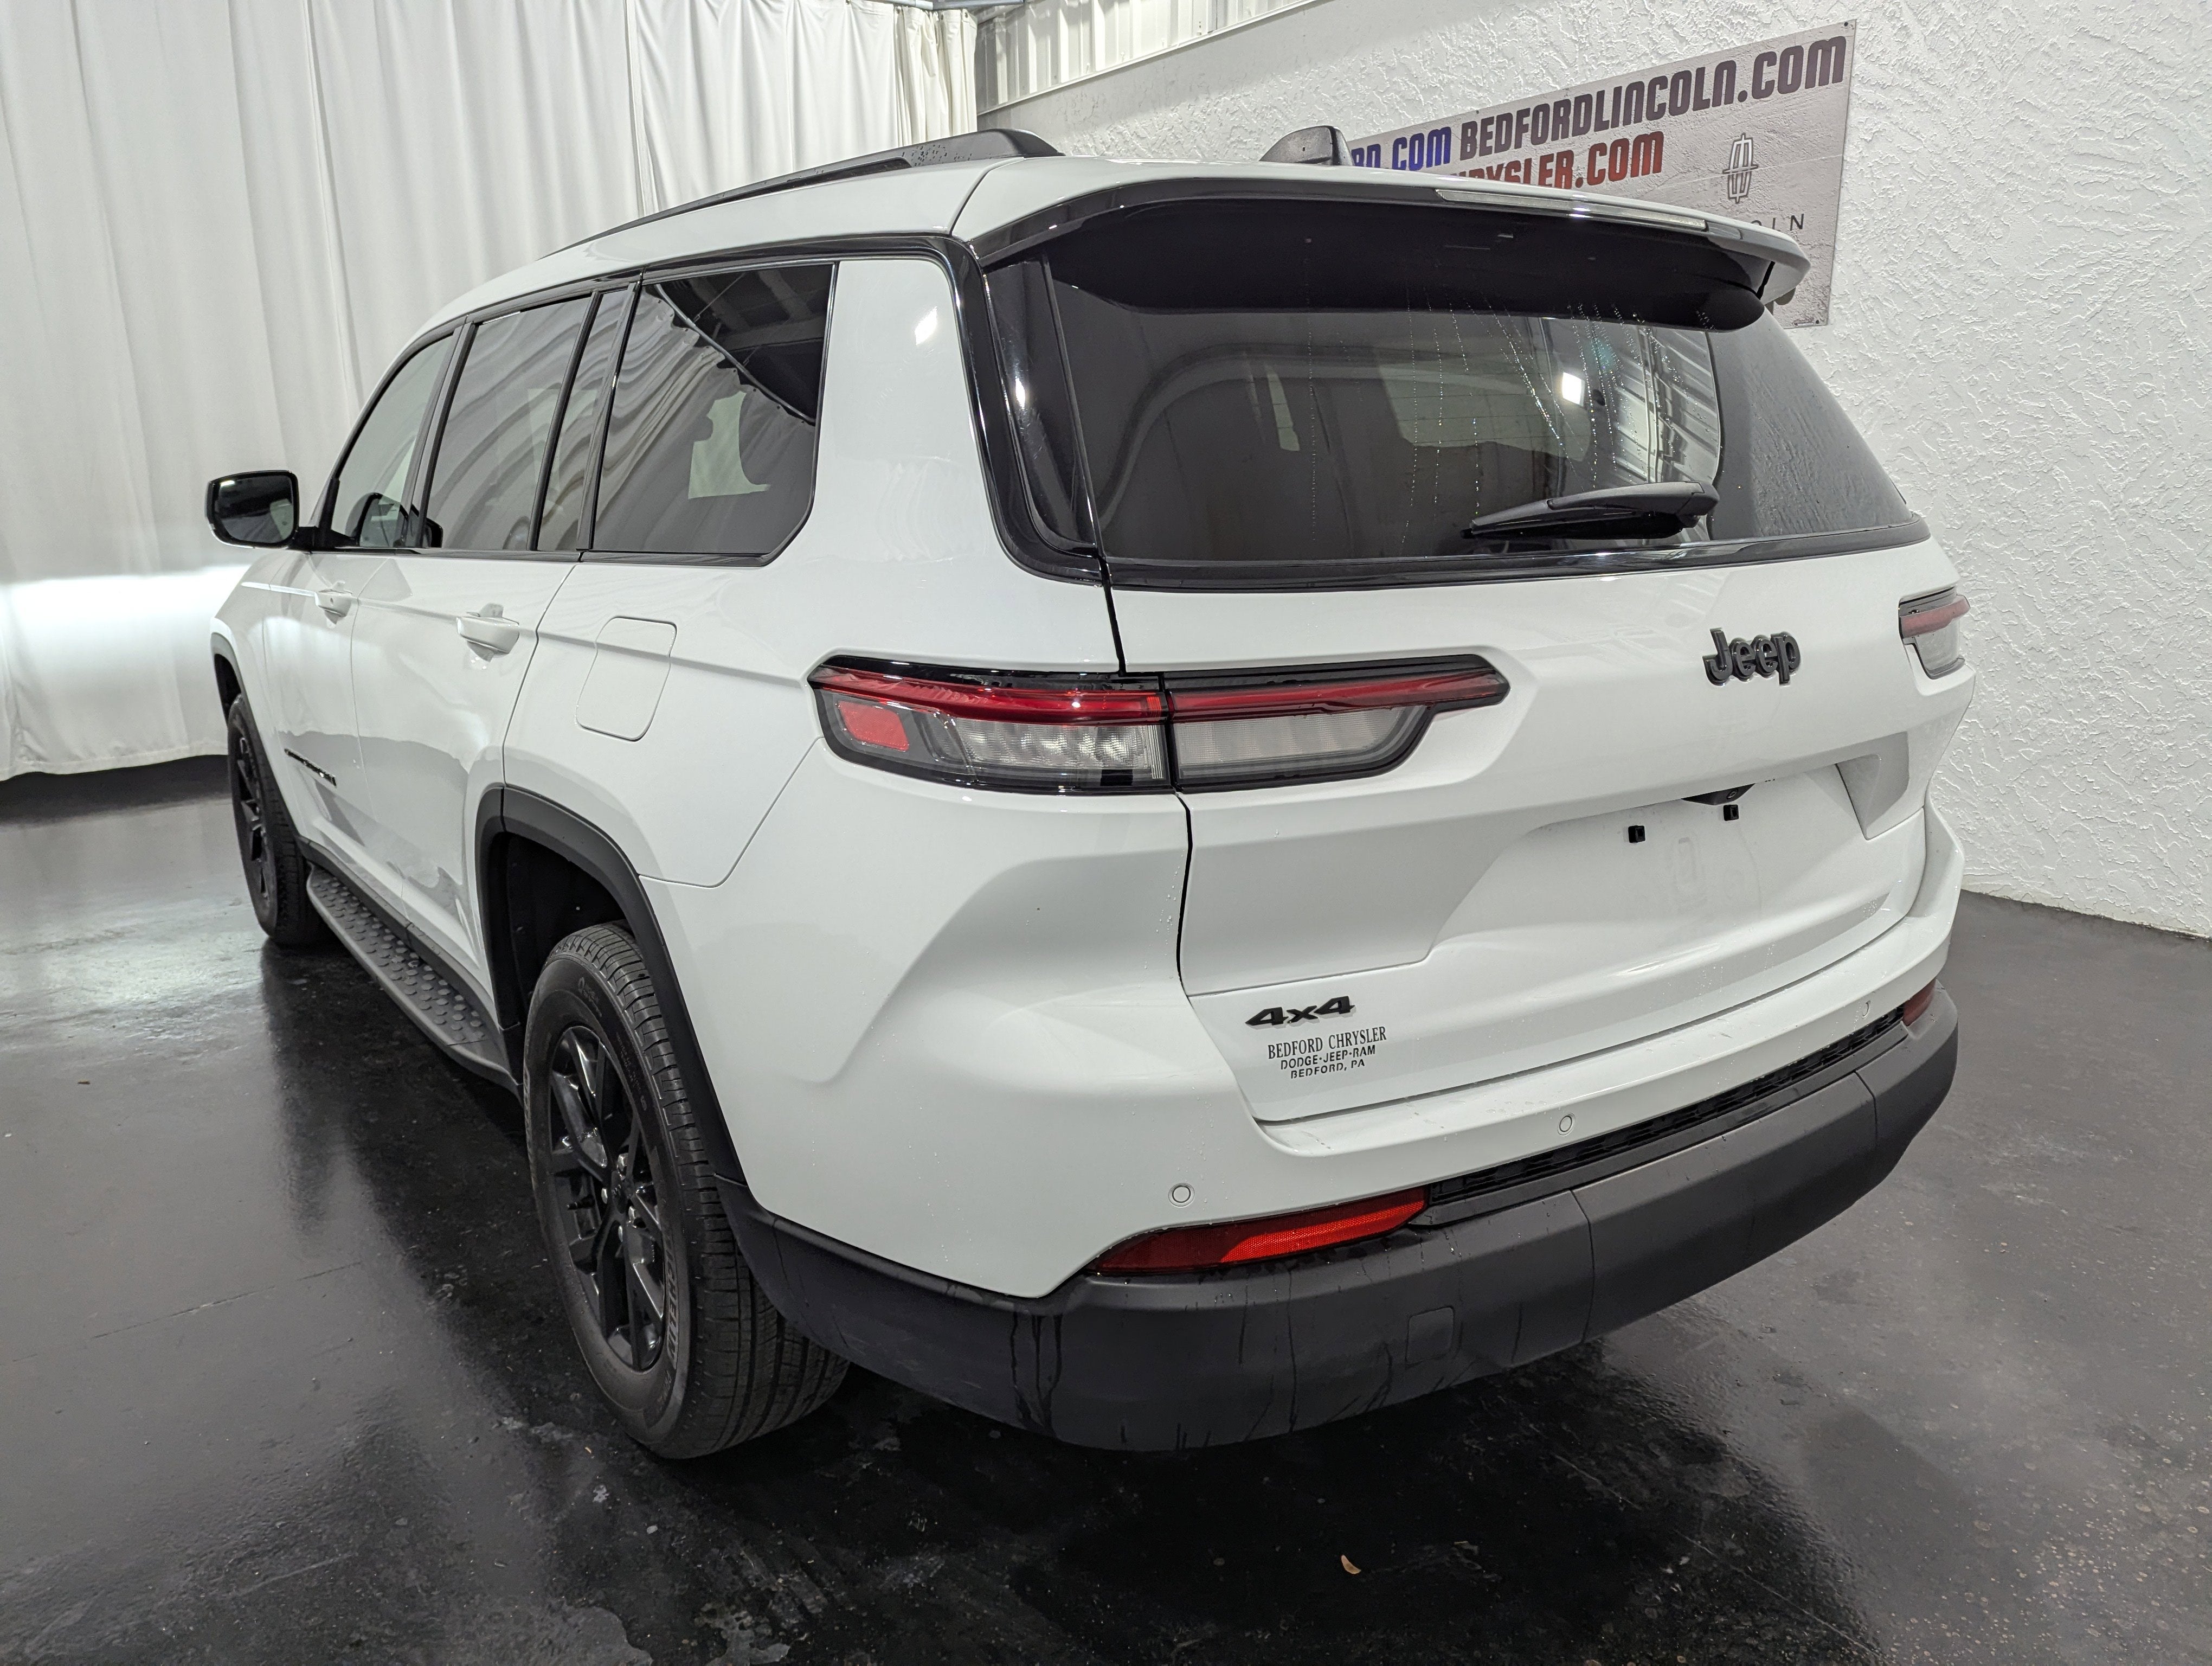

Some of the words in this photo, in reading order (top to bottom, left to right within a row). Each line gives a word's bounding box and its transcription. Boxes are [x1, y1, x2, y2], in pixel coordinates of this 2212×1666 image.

[1460, 36, 1847, 161] BEDFORDLINCOLN.COM
[1702, 627, 1801, 686] Jeep
[1268, 1037, 1323, 1059] BEDFORD
[1328, 1026, 1387, 1050] CHRYSLER
[1291, 1063, 1347, 1079] BEDFORD,
[1351, 1059, 1365, 1068] PA
